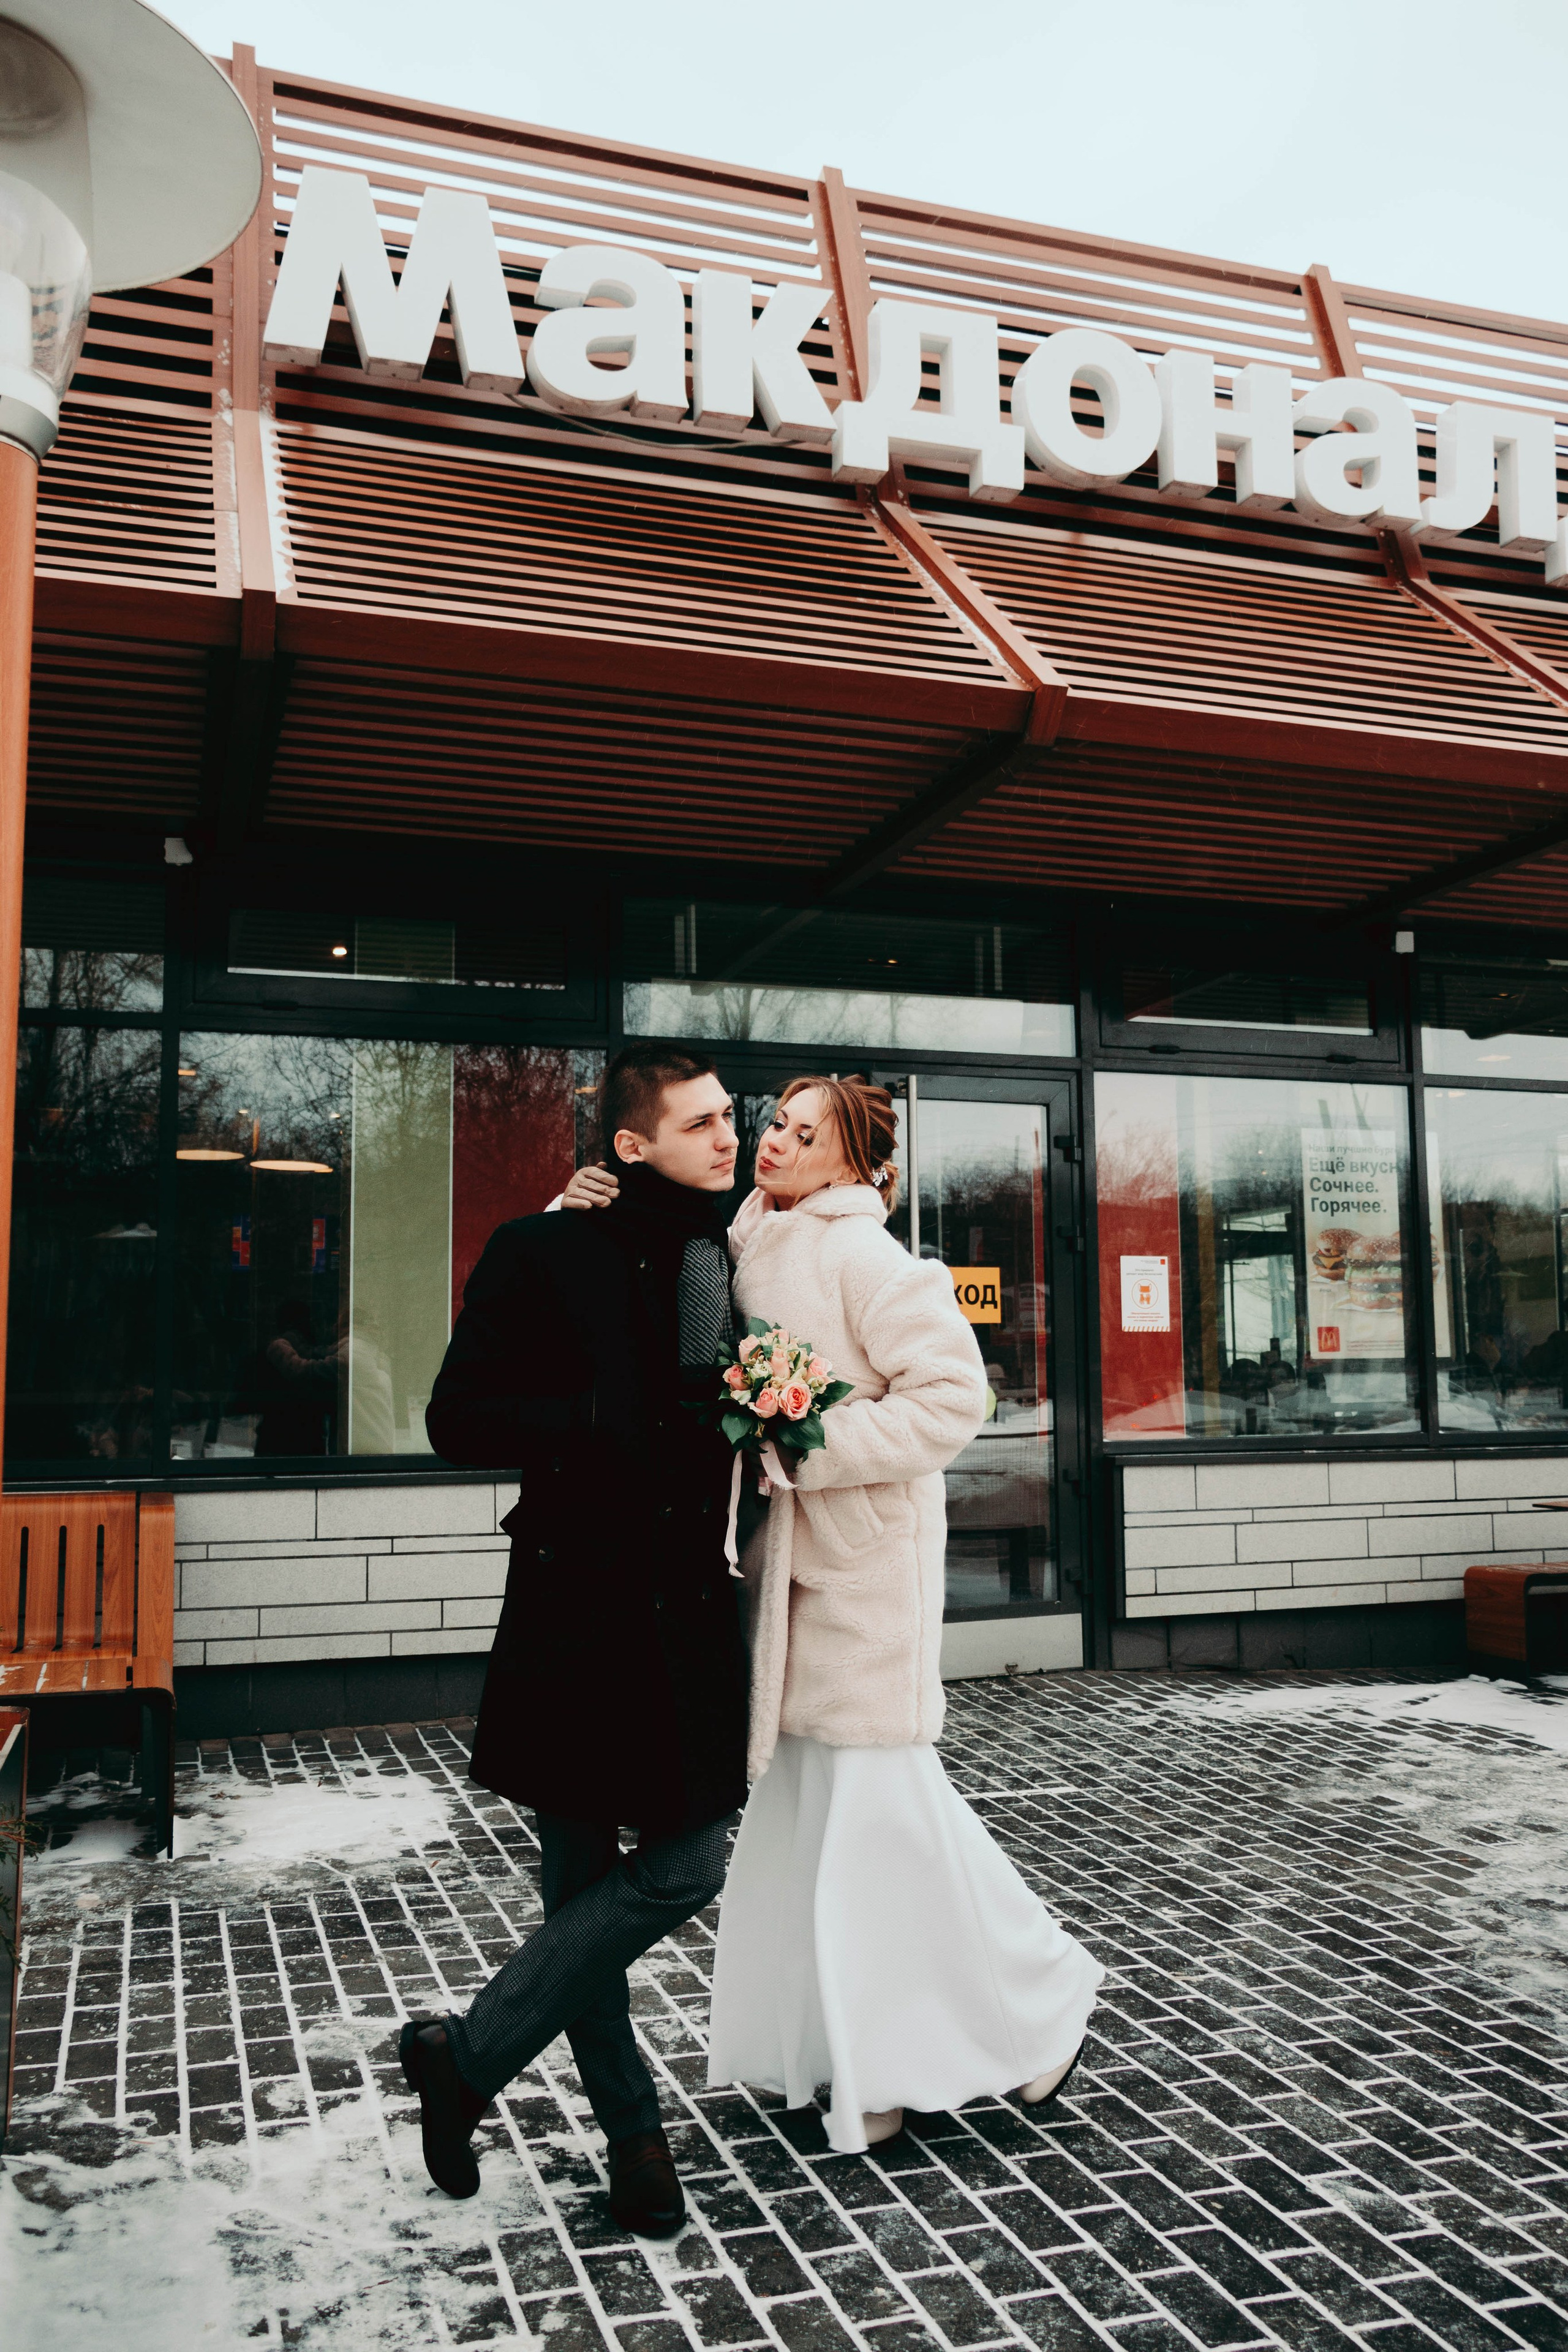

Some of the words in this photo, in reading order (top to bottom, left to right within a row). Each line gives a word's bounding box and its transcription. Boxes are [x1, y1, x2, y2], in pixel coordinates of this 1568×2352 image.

[263, 164, 1568, 584] Макдонал
[1374, 1146, 1395, 1156] бург
[1310, 1157, 1345, 1174] Ещё
[1350, 1161, 1397, 1177] вкусн
[1310, 1177, 1378, 1193] Сочнее.
[1311, 1197, 1386, 1216] Горячее.
[954, 1284, 997, 1309] ХОД
